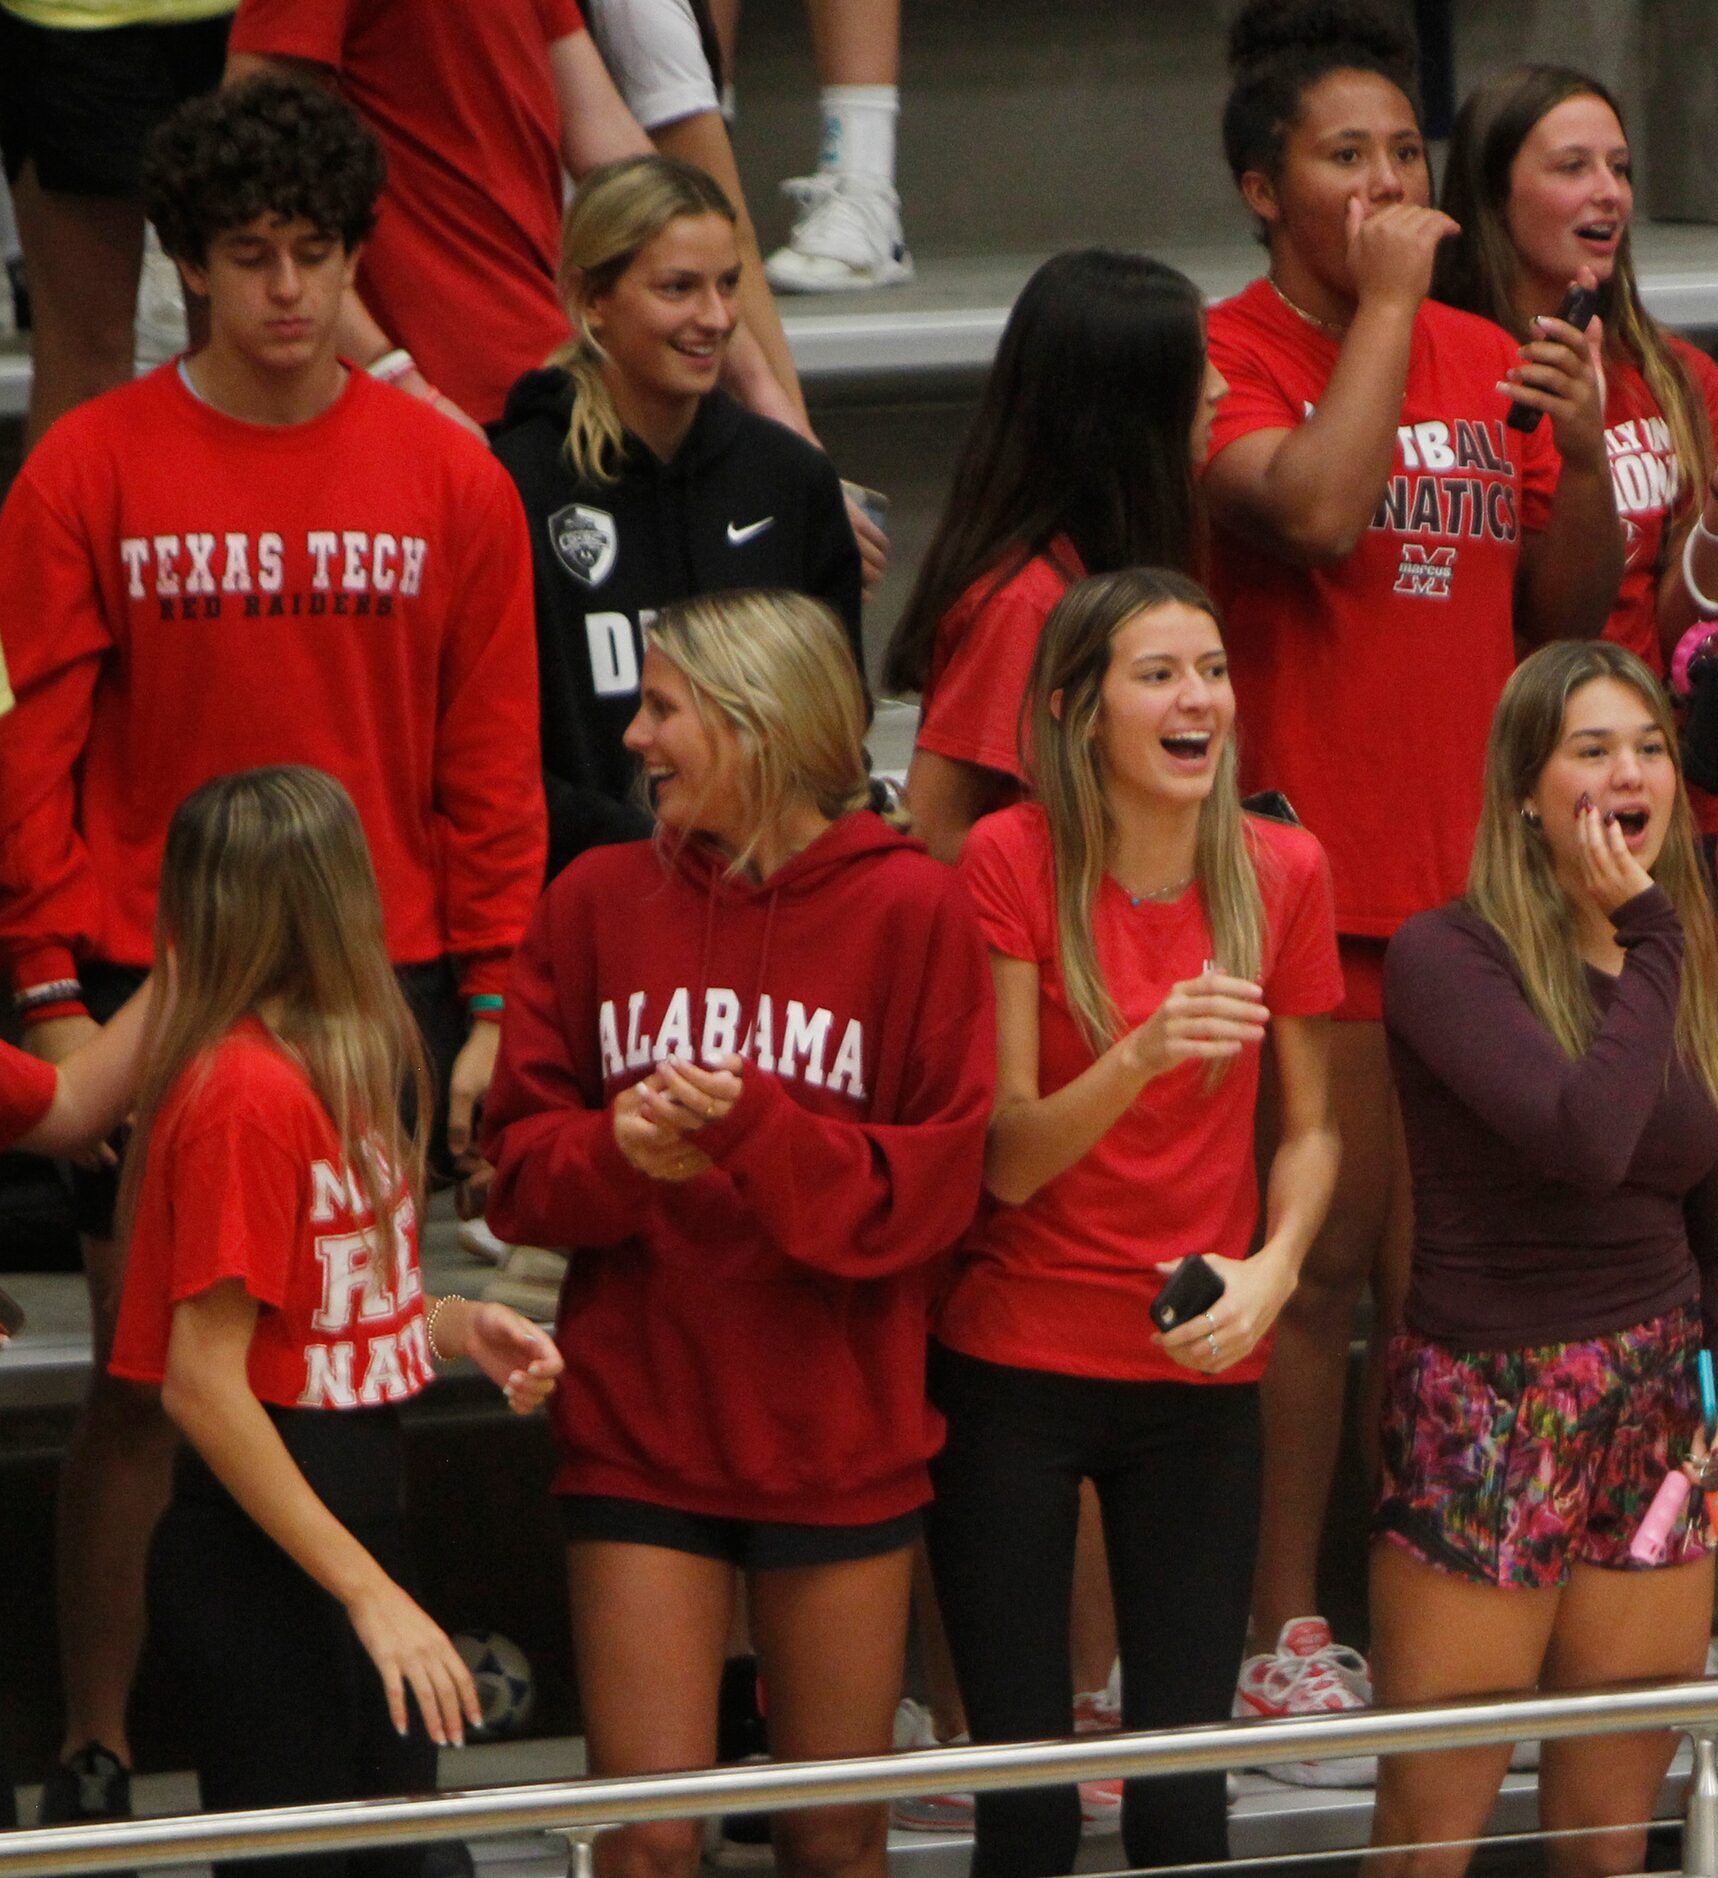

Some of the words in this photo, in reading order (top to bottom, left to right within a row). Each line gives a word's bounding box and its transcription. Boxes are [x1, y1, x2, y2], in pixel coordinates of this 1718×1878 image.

[120, 531, 283, 600] TEXAS
[306, 530, 427, 598] TECH
[159, 596, 221, 623] RED
[243, 592, 395, 619] RAIDERS
[599, 986, 867, 1098] ALABAMA
